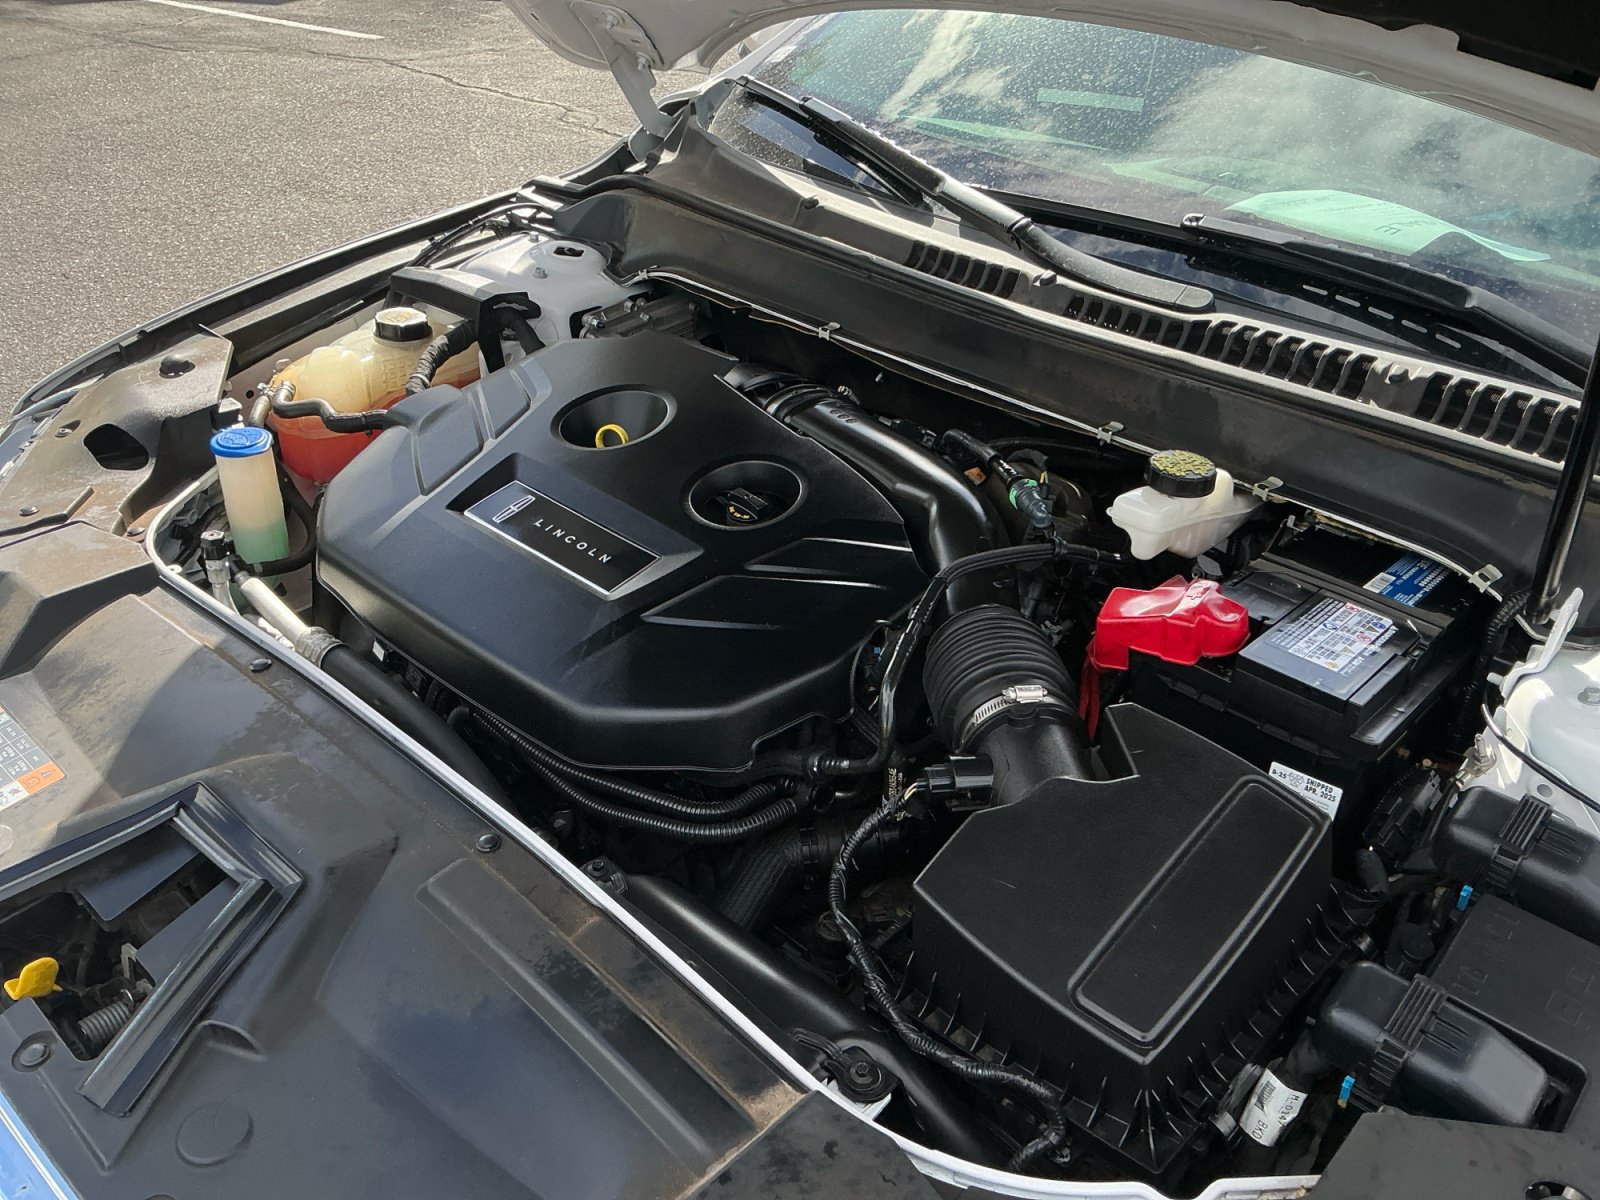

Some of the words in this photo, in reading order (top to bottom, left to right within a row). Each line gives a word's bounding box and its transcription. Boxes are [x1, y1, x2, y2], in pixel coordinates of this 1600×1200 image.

[533, 518, 612, 563] LINCOLN
[1304, 785, 1319, 796] APR.
[1320, 791, 1337, 802] 2025
[1306, 778, 1334, 794] SHIPPED
[1251, 1119, 1269, 1140] BKD
